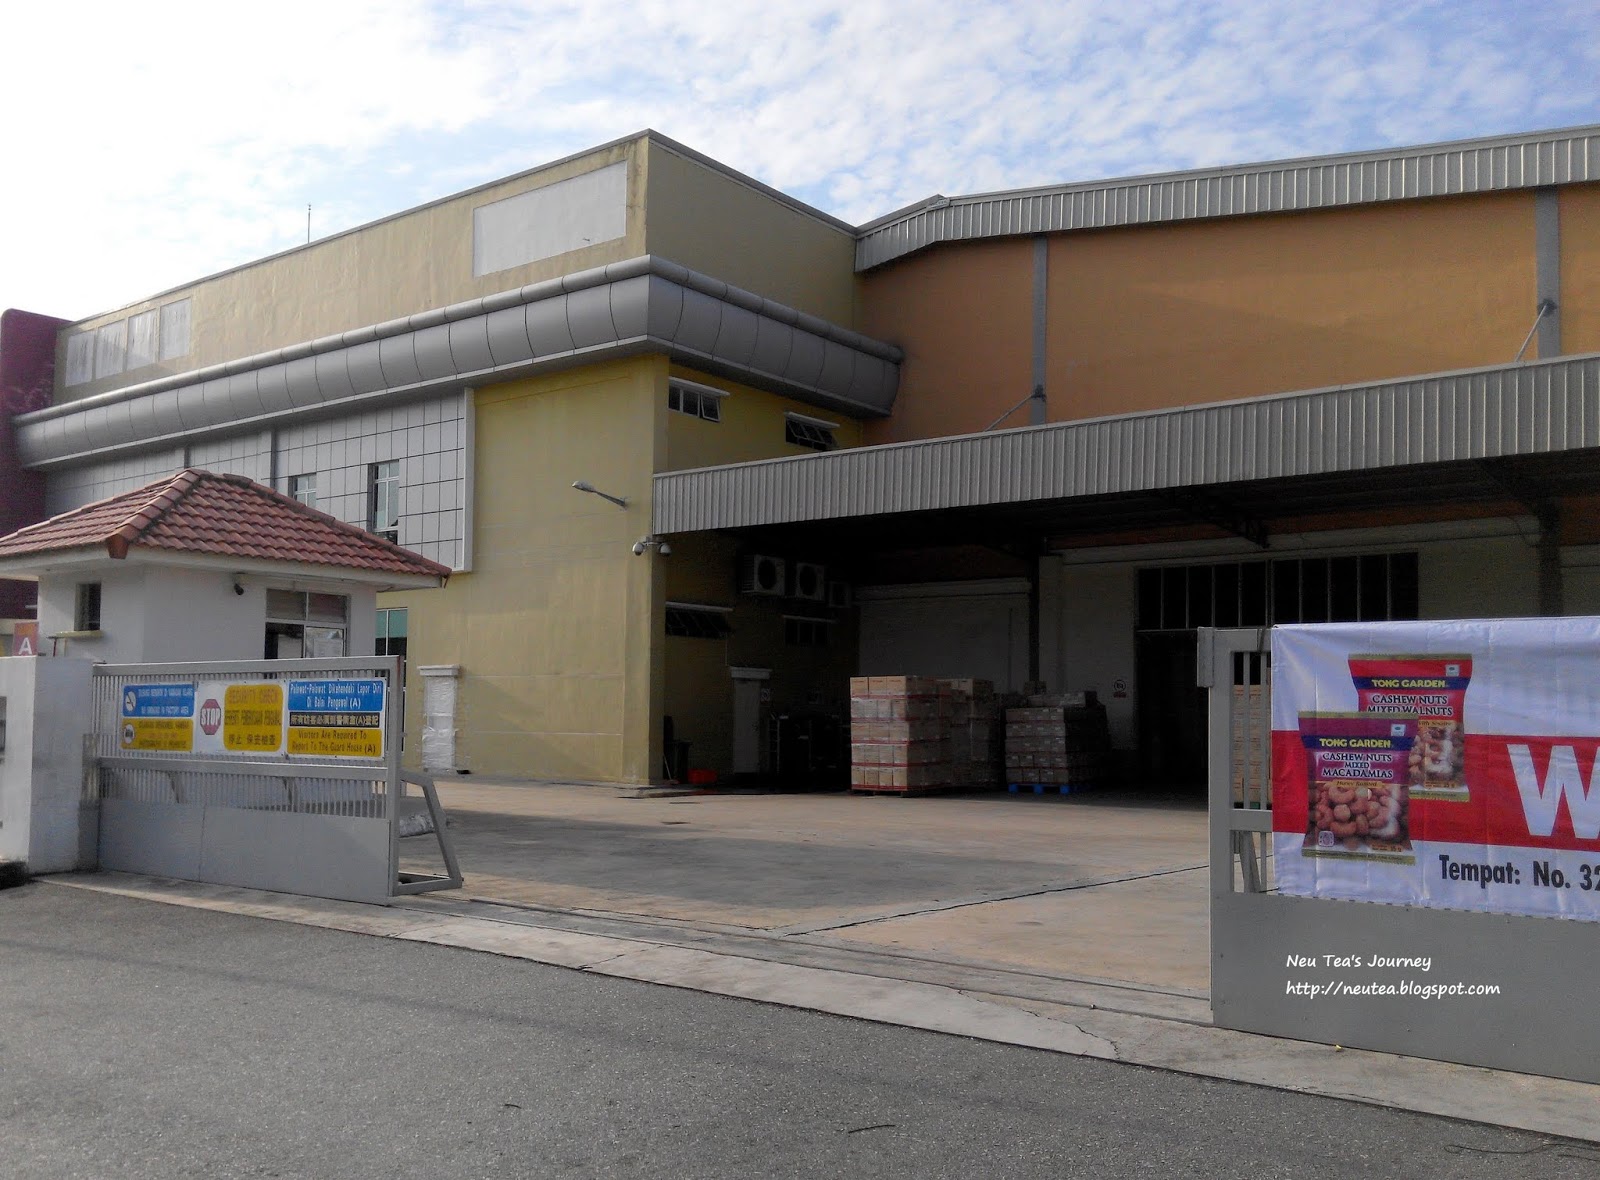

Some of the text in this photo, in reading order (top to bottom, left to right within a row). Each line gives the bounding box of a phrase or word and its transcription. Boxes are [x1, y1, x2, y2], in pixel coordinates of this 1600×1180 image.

[18, 637, 33, 655] A
[1371, 679, 1446, 688] TONG GARDEN
[349, 698, 361, 709] (A)
[1372, 695, 1448, 705] CASHEW NUTS
[201, 708, 220, 725] STOP
[321, 730, 331, 740] Are
[359, 730, 367, 740] To
[319, 741, 328, 752] The
[364, 744, 376, 755] (A)
[1319, 739, 1391, 748] TONG GARDEN
[1322, 753, 1392, 762] CASHEW NUTS
[1344, 761, 1370, 769] MIXED
[1322, 768, 1393, 778] MACADAMIAS
[1439, 854, 1520, 889] Tempat:
[1533, 861, 1571, 889] No.
